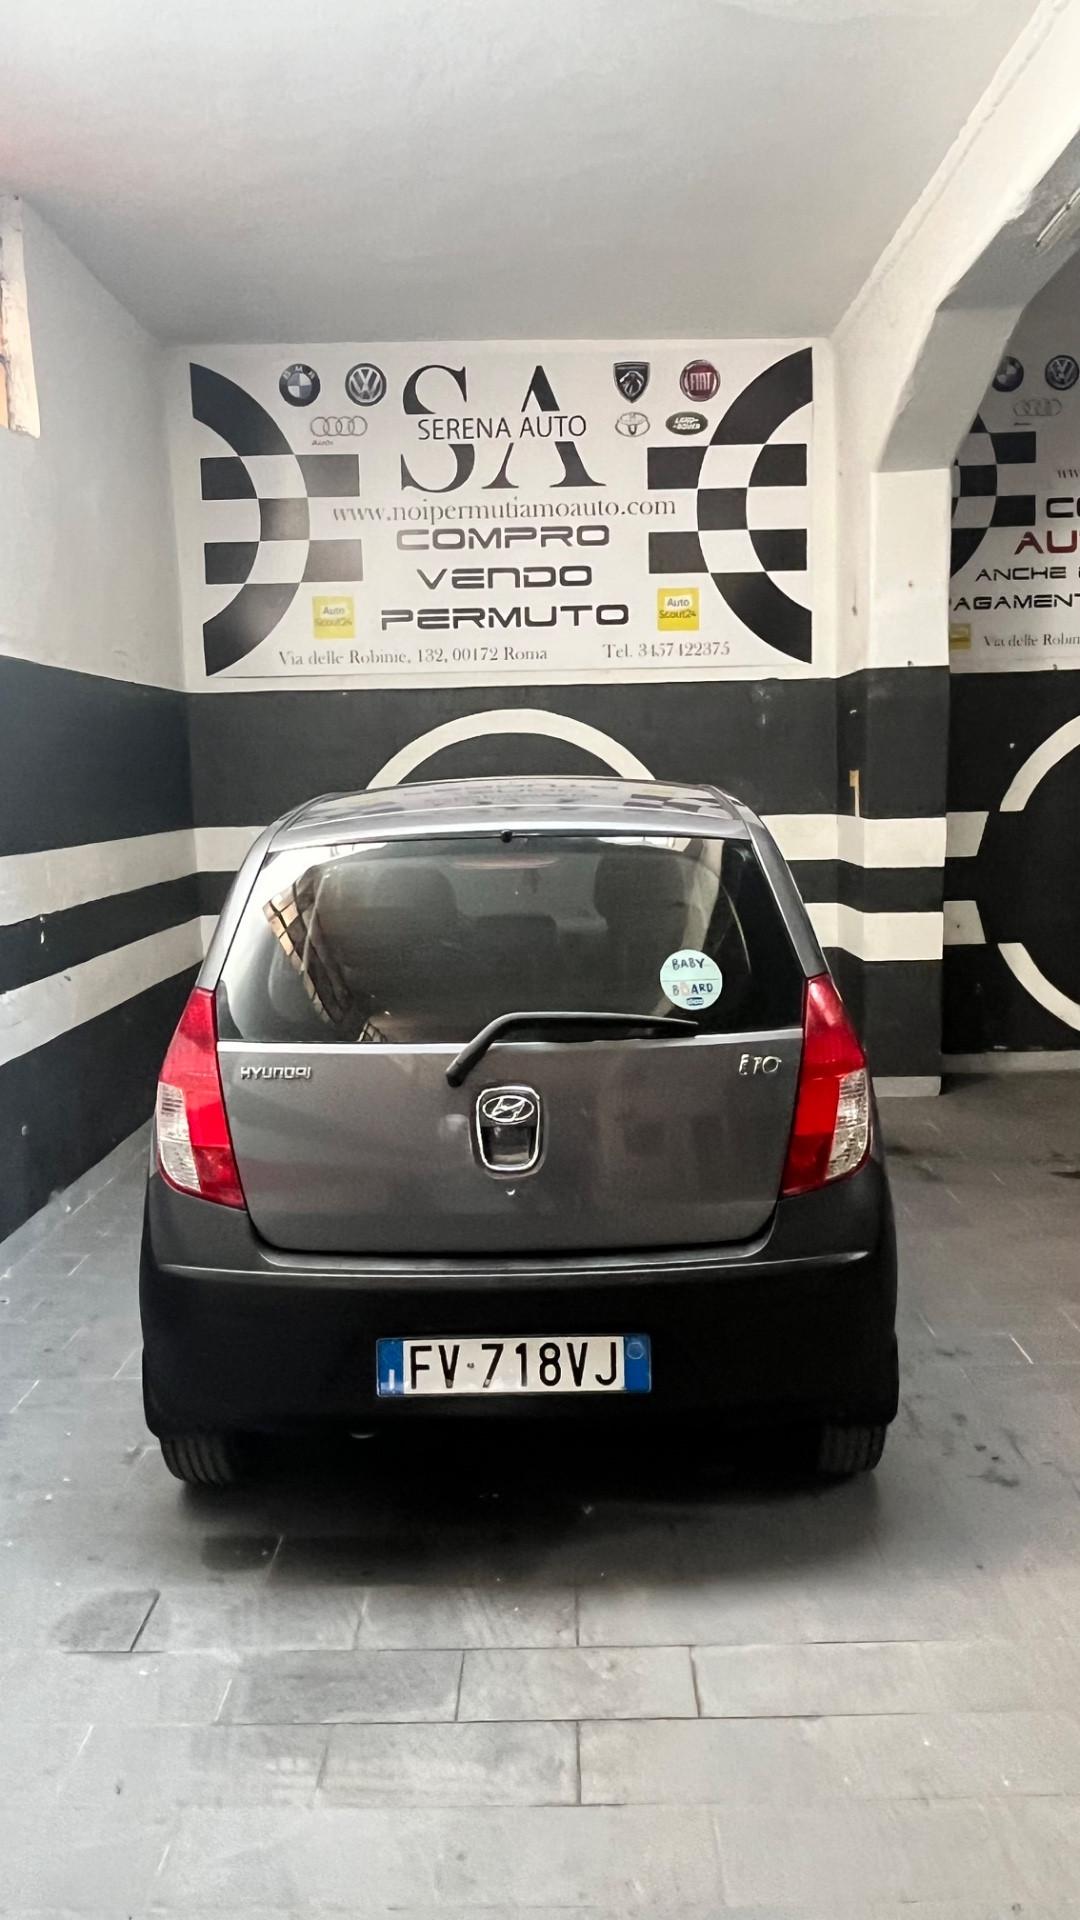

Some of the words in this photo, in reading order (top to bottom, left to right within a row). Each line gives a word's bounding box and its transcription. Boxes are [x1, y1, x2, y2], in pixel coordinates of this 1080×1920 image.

[690, 371, 713, 391] FIAT
[418, 417, 512, 440] SERENA
[519, 414, 587, 438] AUTO
[332, 498, 677, 524] www.noipermutiamoauto.com
[1046, 497, 1080, 519] C
[396, 525, 610, 551] COMPRO
[1014, 530, 1080, 555] AU
[416, 565, 593, 590] VENDO
[975, 566, 1067, 583] ANCHE
[322, 606, 345, 617] Auto
[667, 598, 690, 607] Auto
[949, 592, 1080, 612] AGAMEN
[381, 604, 629, 631] PERMUTO
[279, 651, 304, 666] Via
[308, 649, 344, 665] delle
[417, 648, 448, 663] 132,
[452, 647, 498, 663] 00172
[504, 646, 548, 662] Roma
[602, 643, 633, 659] Tel.
[672, 958, 705, 970] BABY
[410, 1344, 460, 1390] FV
[481, 1341, 617, 1388] 718VJ
